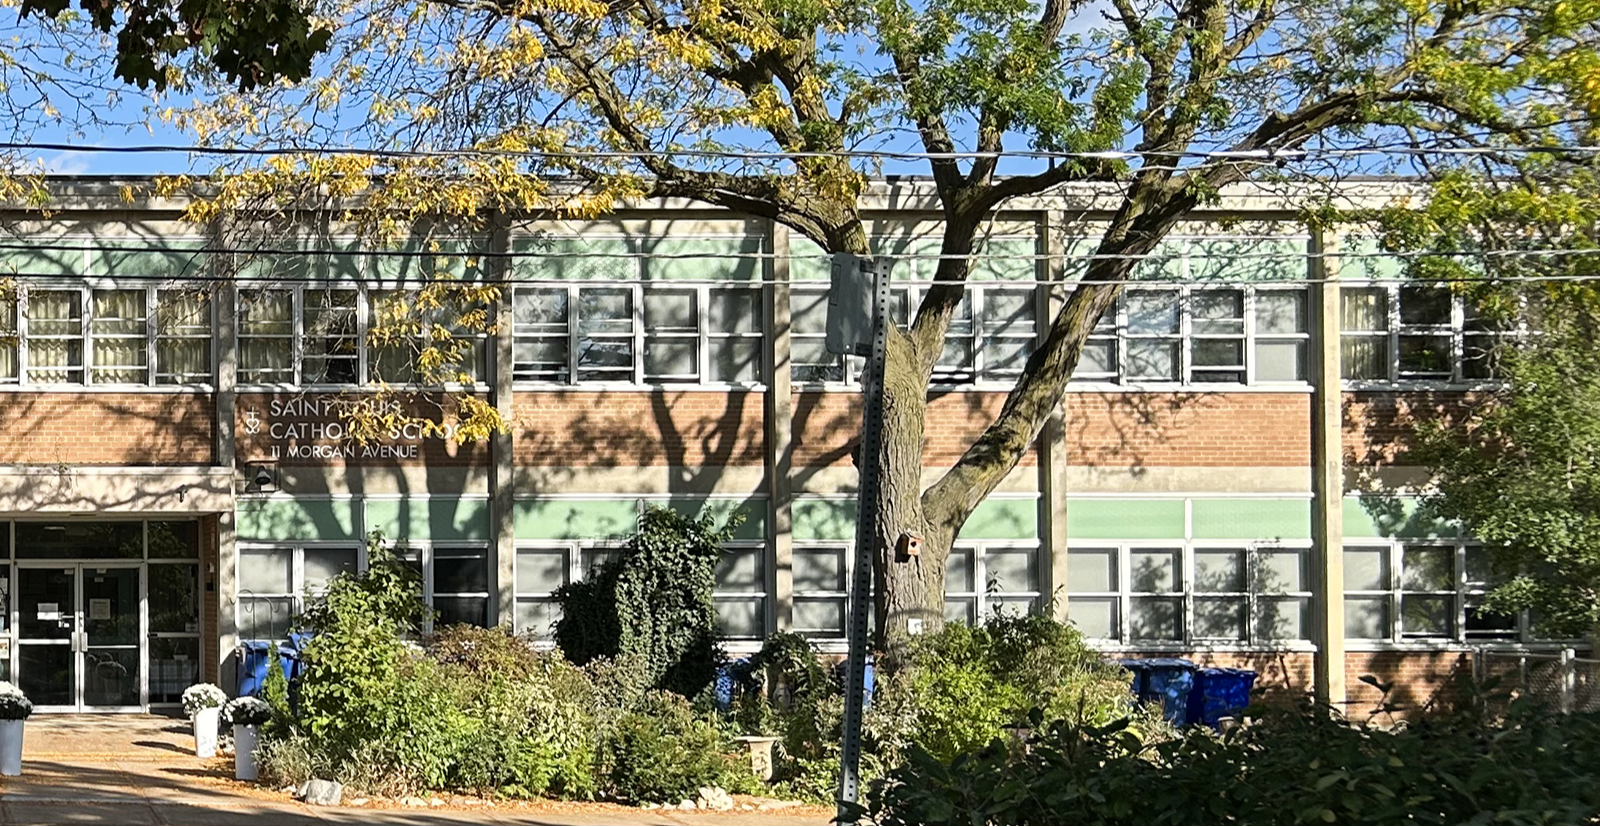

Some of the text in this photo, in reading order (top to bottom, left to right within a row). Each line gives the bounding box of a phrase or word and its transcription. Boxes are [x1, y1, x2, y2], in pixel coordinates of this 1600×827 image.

[270, 399, 331, 416] SAINT
[270, 445, 418, 458] 11 MORGAN AVENUE
